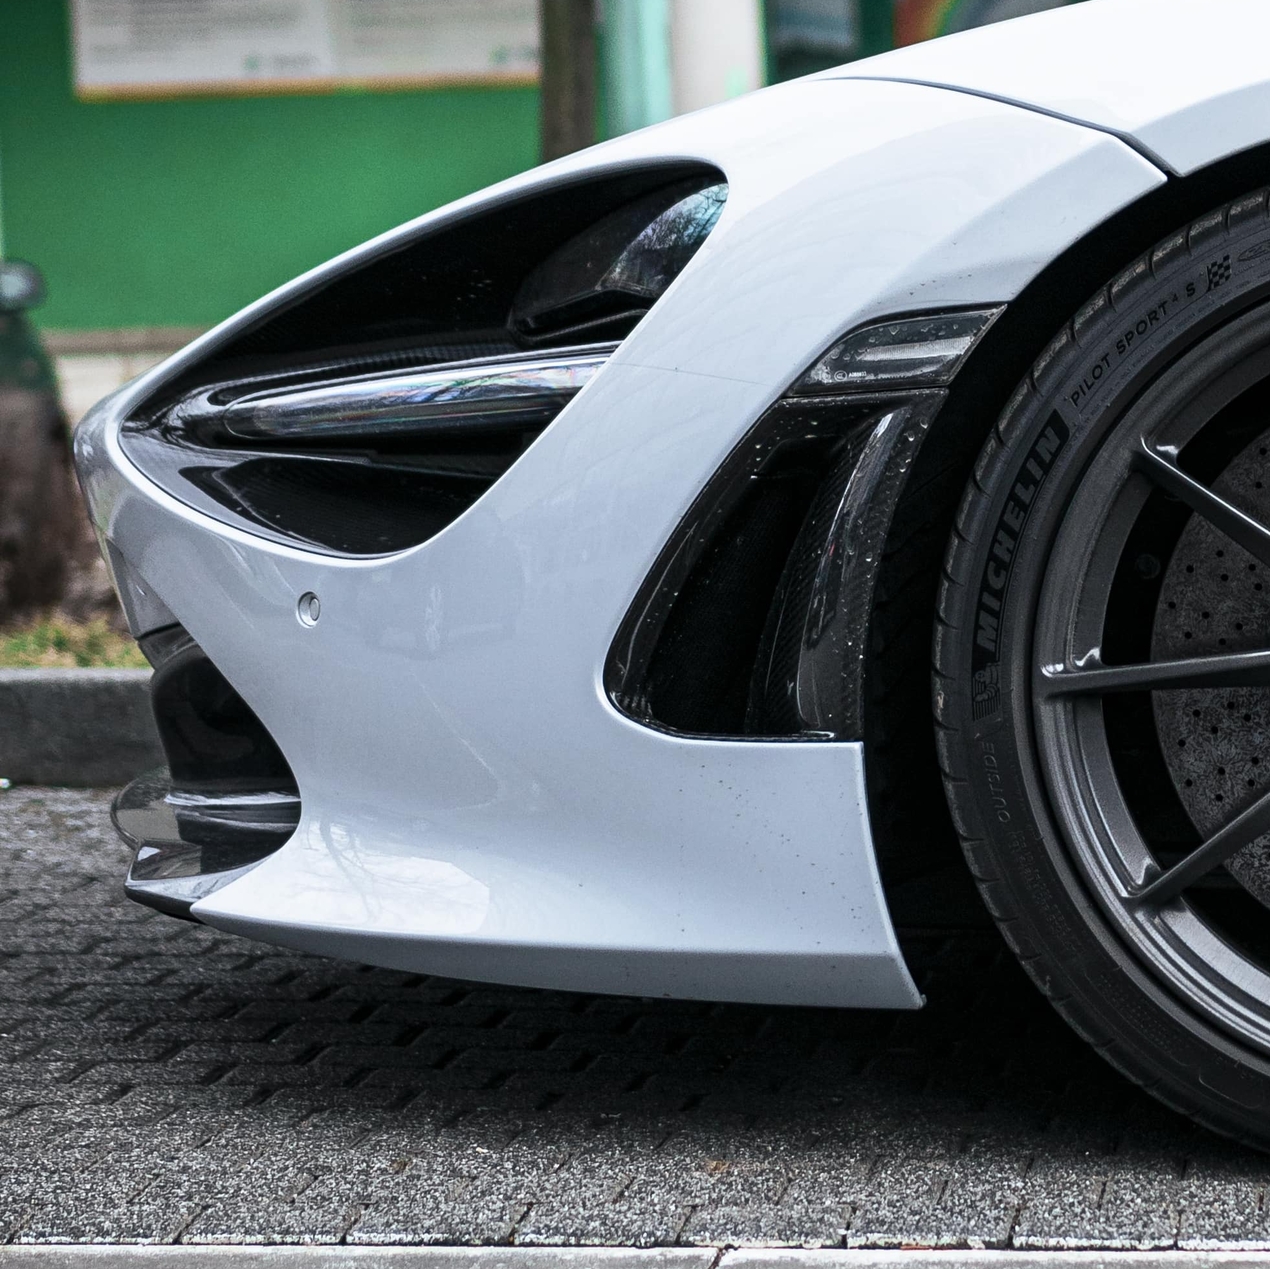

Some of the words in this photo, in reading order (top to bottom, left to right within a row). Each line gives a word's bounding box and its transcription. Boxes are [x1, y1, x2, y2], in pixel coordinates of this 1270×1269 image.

[1070, 352, 1110, 407] PILOT
[1116, 301, 1167, 355] SPORT
[1186, 282, 1195, 297] S
[975, 421, 1061, 654] MICHELIN
[985, 743, 1011, 823] OUTSIDE
